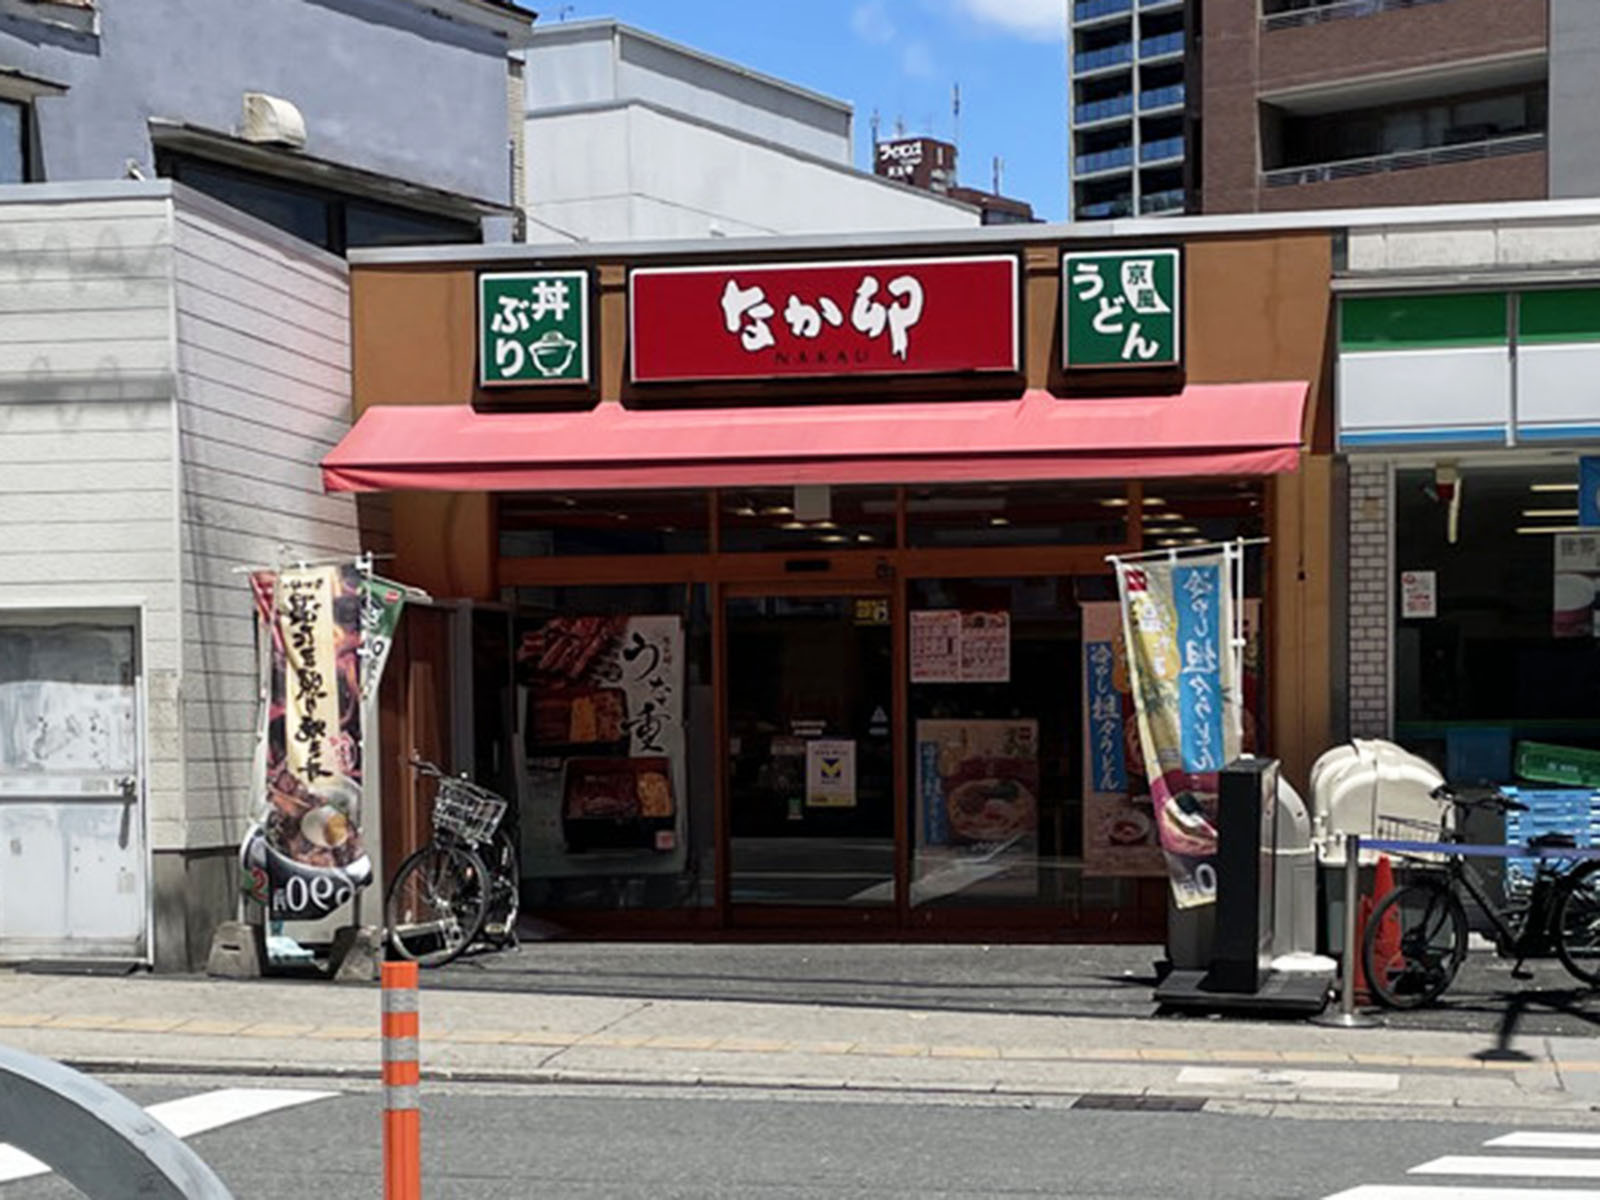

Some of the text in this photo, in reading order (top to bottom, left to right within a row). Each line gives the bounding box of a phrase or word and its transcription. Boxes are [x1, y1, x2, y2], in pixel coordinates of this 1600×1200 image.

[720, 275, 924, 362] なか卯
[1072, 262, 1159, 360] うどん
[1126, 264, 1157, 309] 京風
